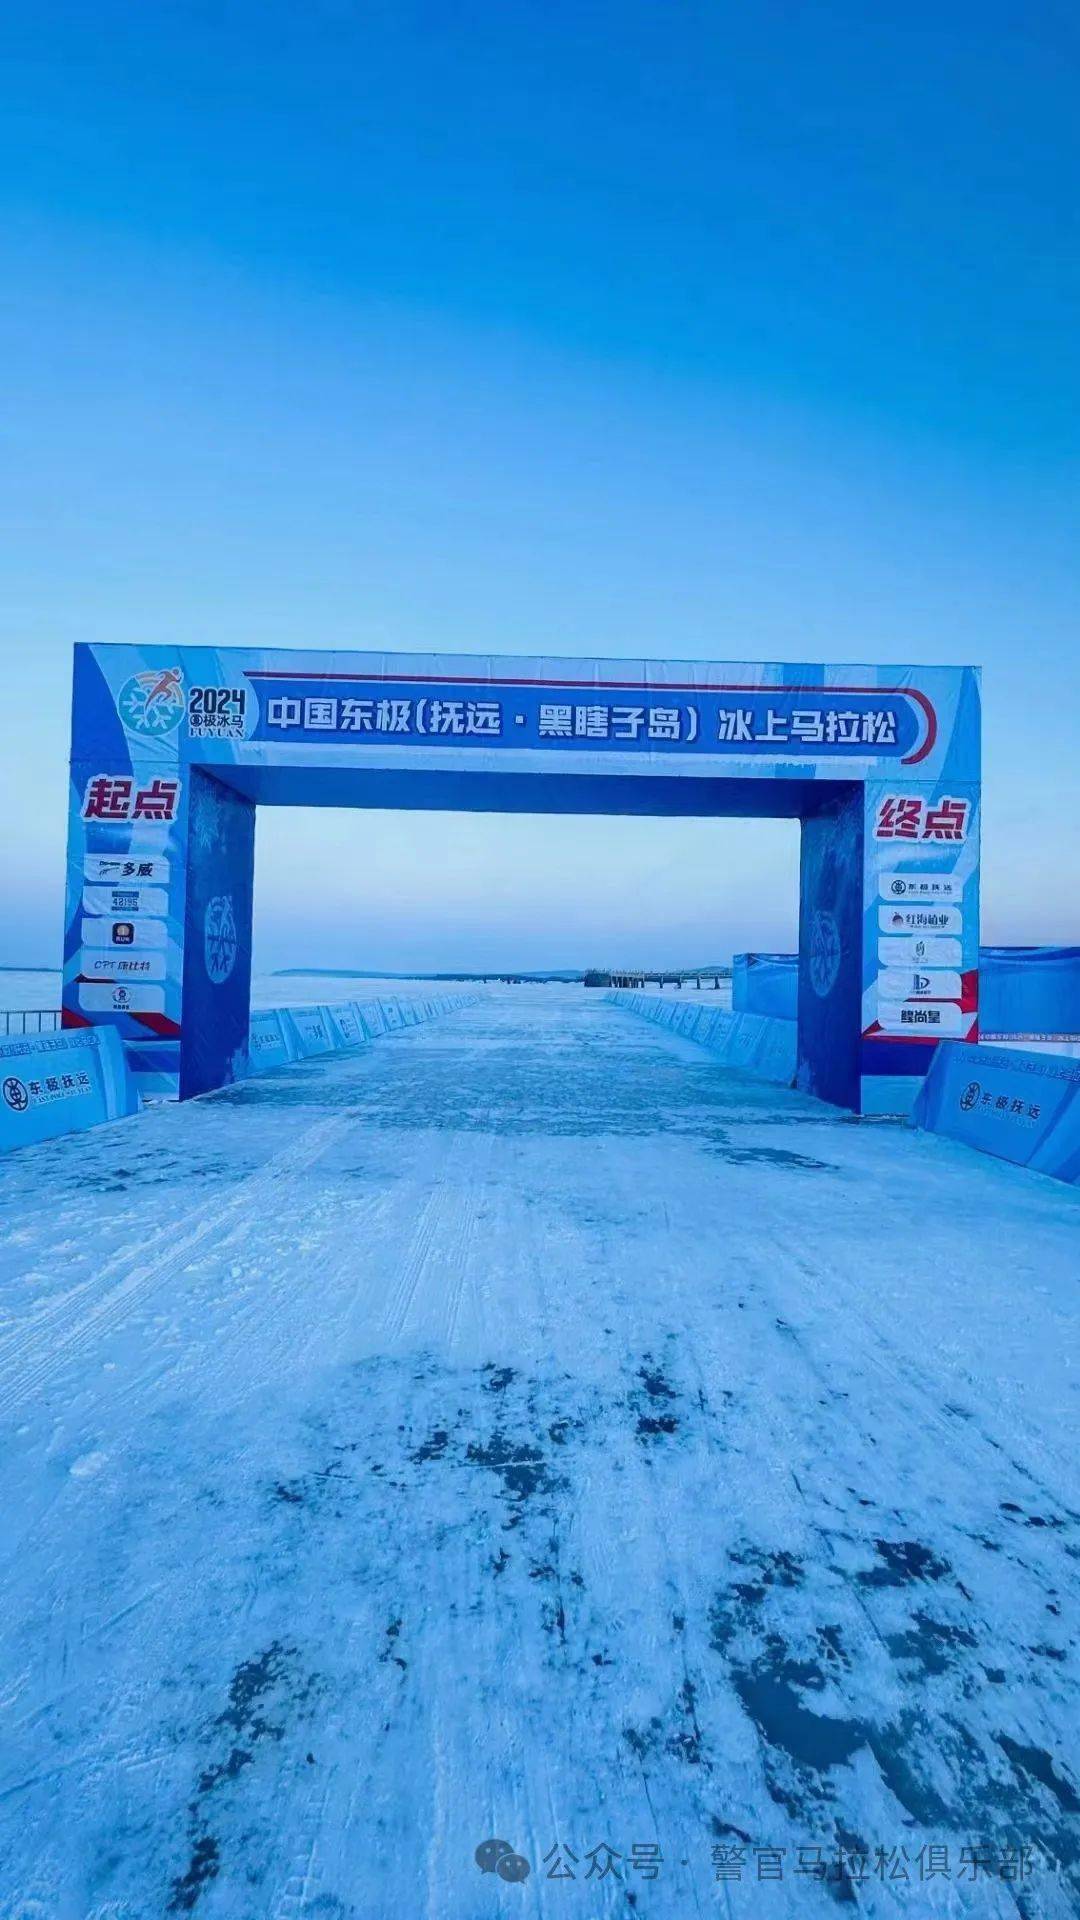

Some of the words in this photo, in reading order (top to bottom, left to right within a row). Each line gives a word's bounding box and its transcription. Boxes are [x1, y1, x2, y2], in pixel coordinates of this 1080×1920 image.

[189, 687, 245, 715] 2024
[83, 777, 179, 821] 起点
[876, 797, 967, 840] 终点
[121, 861, 154, 877] 多威
[27, 1070, 90, 1095] 东极抚远
